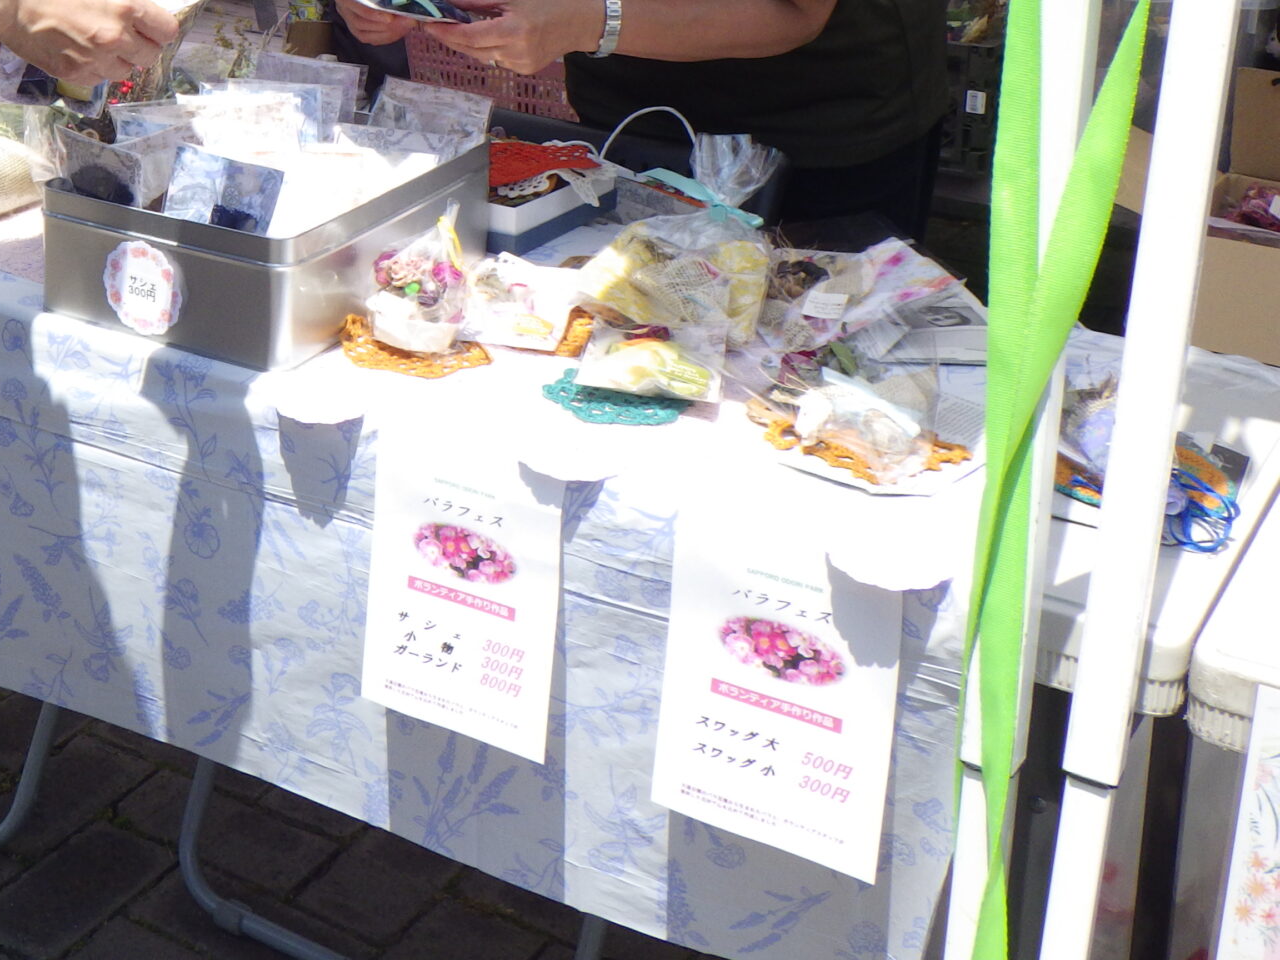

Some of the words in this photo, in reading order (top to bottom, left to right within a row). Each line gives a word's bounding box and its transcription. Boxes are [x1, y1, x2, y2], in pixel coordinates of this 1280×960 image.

[128, 285, 156, 302] 300円
[130, 275, 157, 291] サシェ
[482, 639, 525, 663] 300円
[393, 643, 462, 673] ガーランド
[479, 673, 522, 698] 800円
[480, 656, 523, 680] 300円
[801, 751, 854, 780] 500円
[798, 774, 851, 804] 300円
